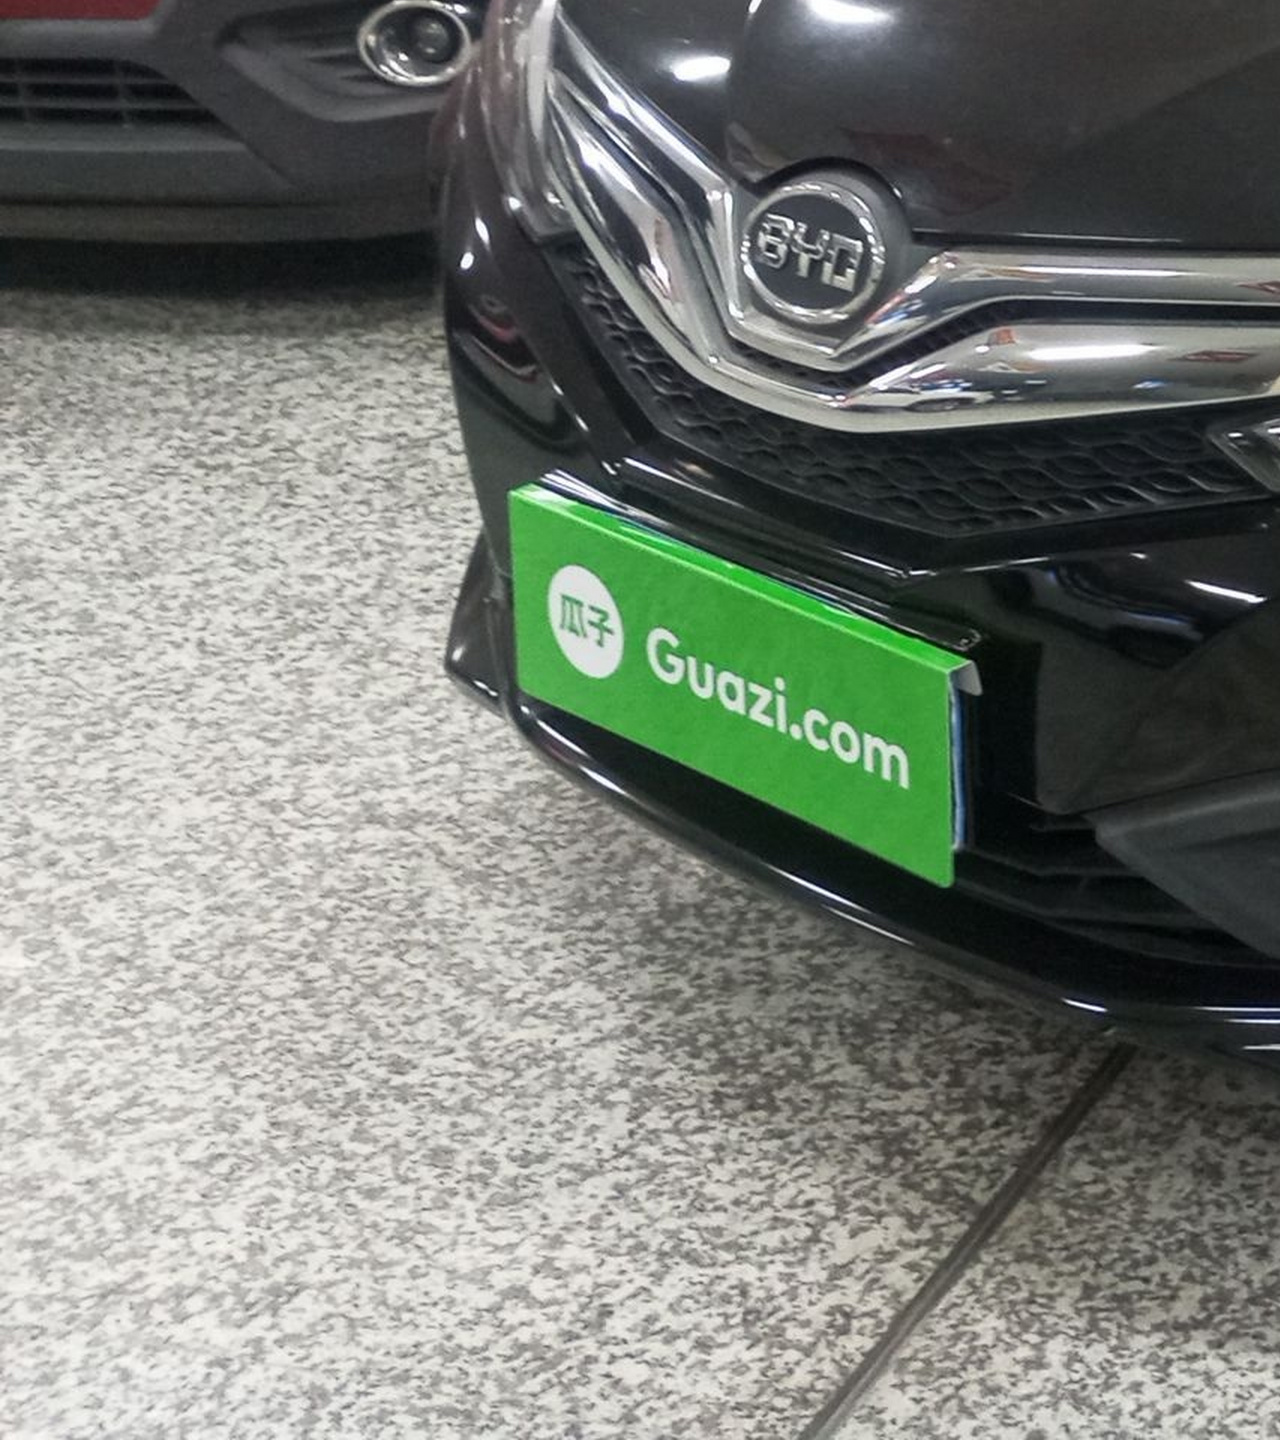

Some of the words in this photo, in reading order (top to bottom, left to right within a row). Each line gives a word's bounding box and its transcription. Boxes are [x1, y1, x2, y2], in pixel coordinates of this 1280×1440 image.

[757, 212, 864, 293] BYD
[559, 593, 616, 648] 瓜子
[646, 627, 910, 790] Guazi.com
